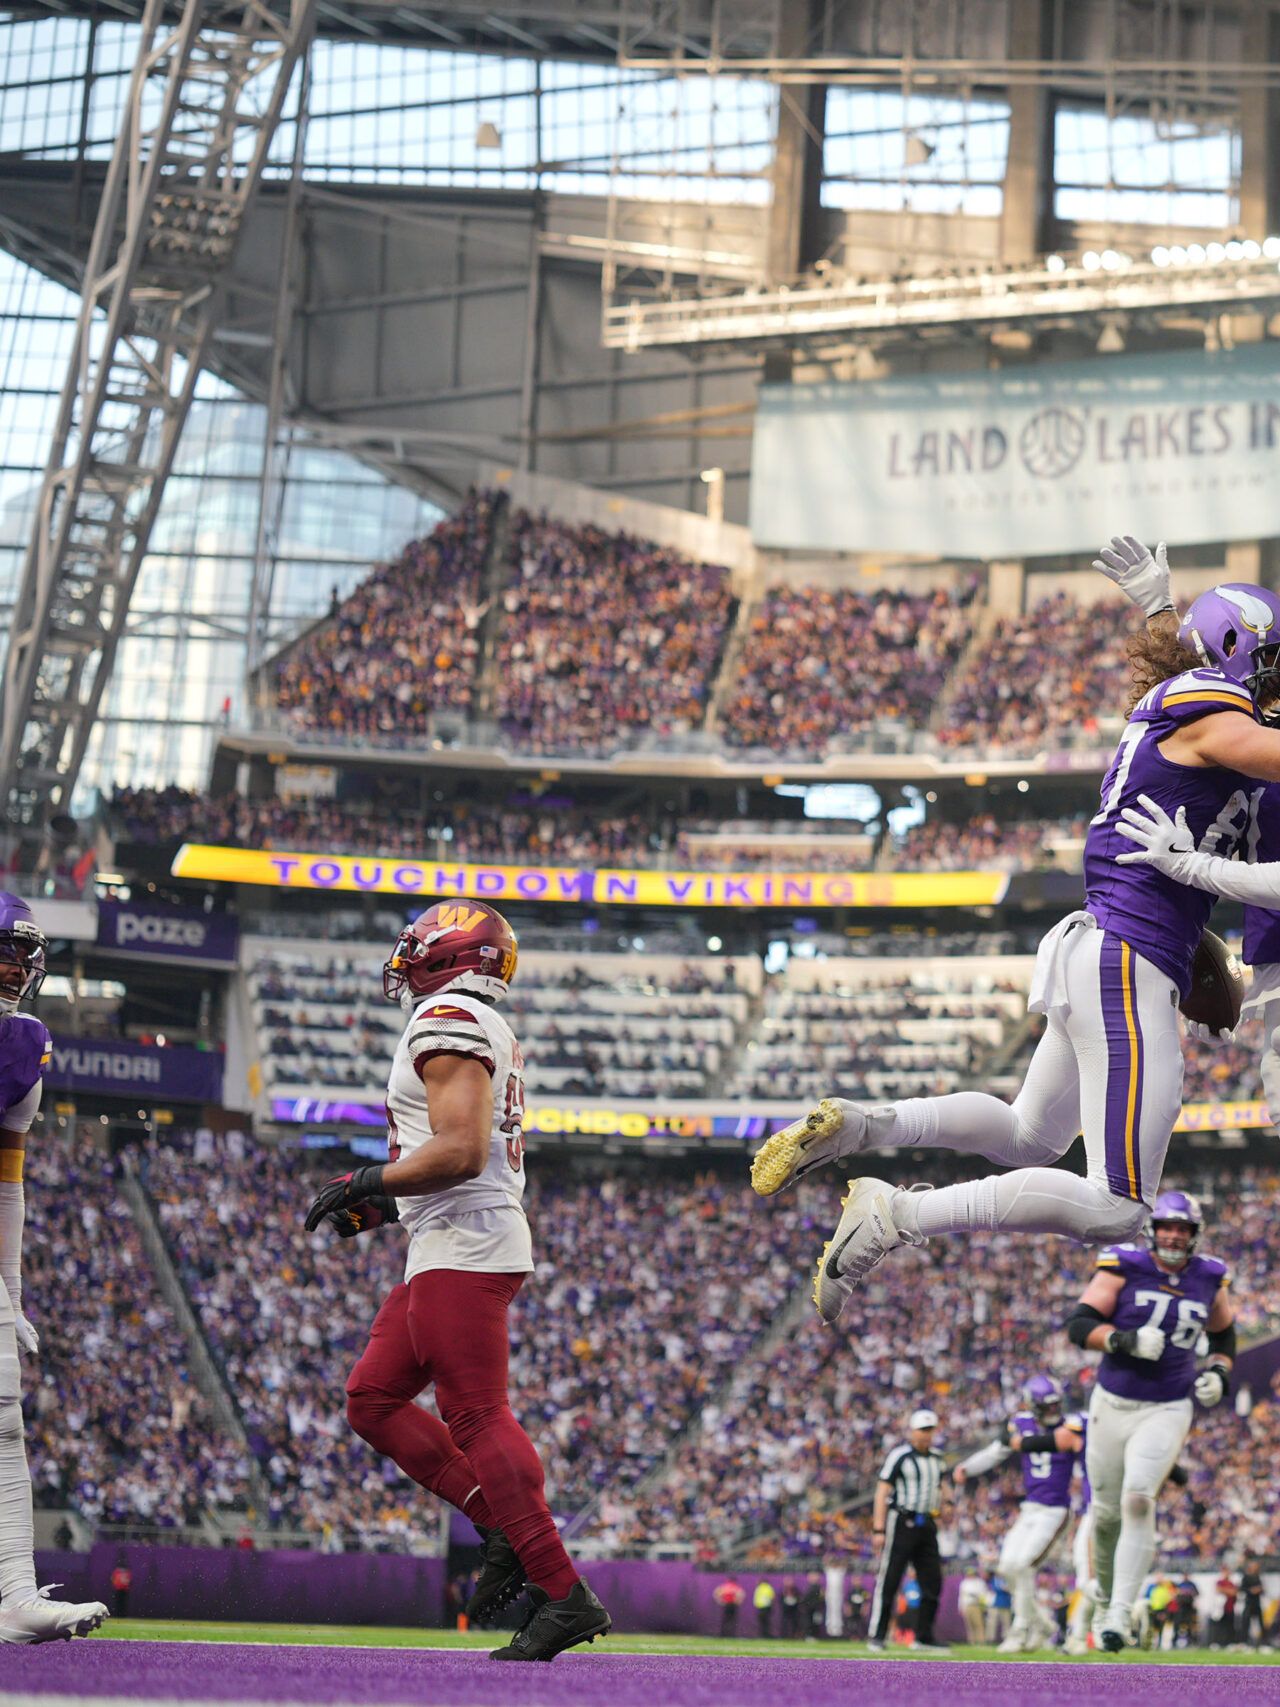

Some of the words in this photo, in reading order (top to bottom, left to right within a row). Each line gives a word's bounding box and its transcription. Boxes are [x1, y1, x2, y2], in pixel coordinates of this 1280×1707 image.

[888, 426, 1008, 478] LAND
[667, 878, 893, 904] VIKING
[116, 912, 206, 948] paze
[1135, 1290, 1208, 1349] 76
